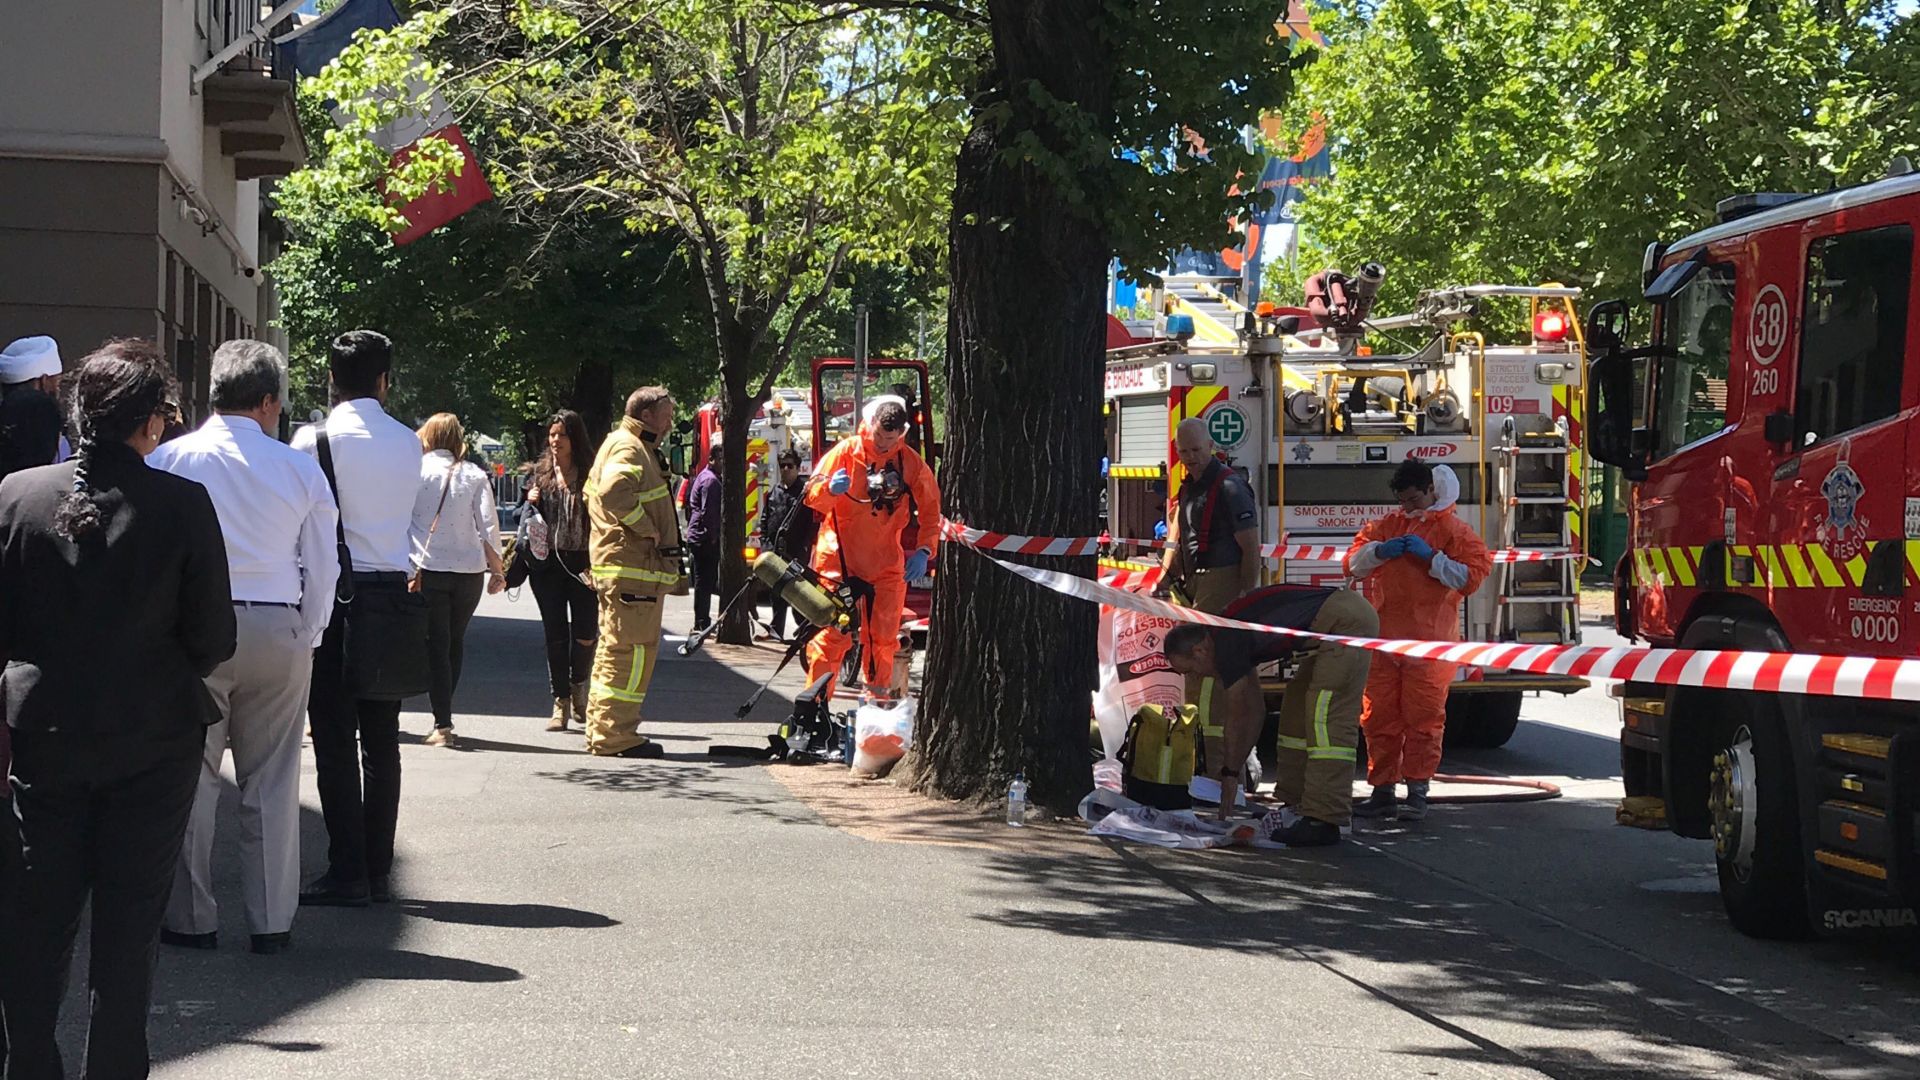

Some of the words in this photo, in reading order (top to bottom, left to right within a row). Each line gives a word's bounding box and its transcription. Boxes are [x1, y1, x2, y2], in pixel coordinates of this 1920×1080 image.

[1755, 303, 1780, 346] 38
[1113, 363, 1144, 389] BRIGADE
[1490, 364, 1526, 373] STRICTLY
[1499, 375, 1530, 384] ACCESS
[1752, 368, 1778, 396] 260
[1416, 445, 1447, 457] MFB
[1294, 506, 1336, 516] SMOKE
[1340, 506, 1365, 516] CAN
[1317, 518, 1356, 527] SMOKE
[1833, 514, 1870, 559] RESCUE
[1848, 597, 1901, 614] EMERGENCY
[1864, 615, 1899, 642] 000
[1823, 909, 1918, 929] SCANIA
